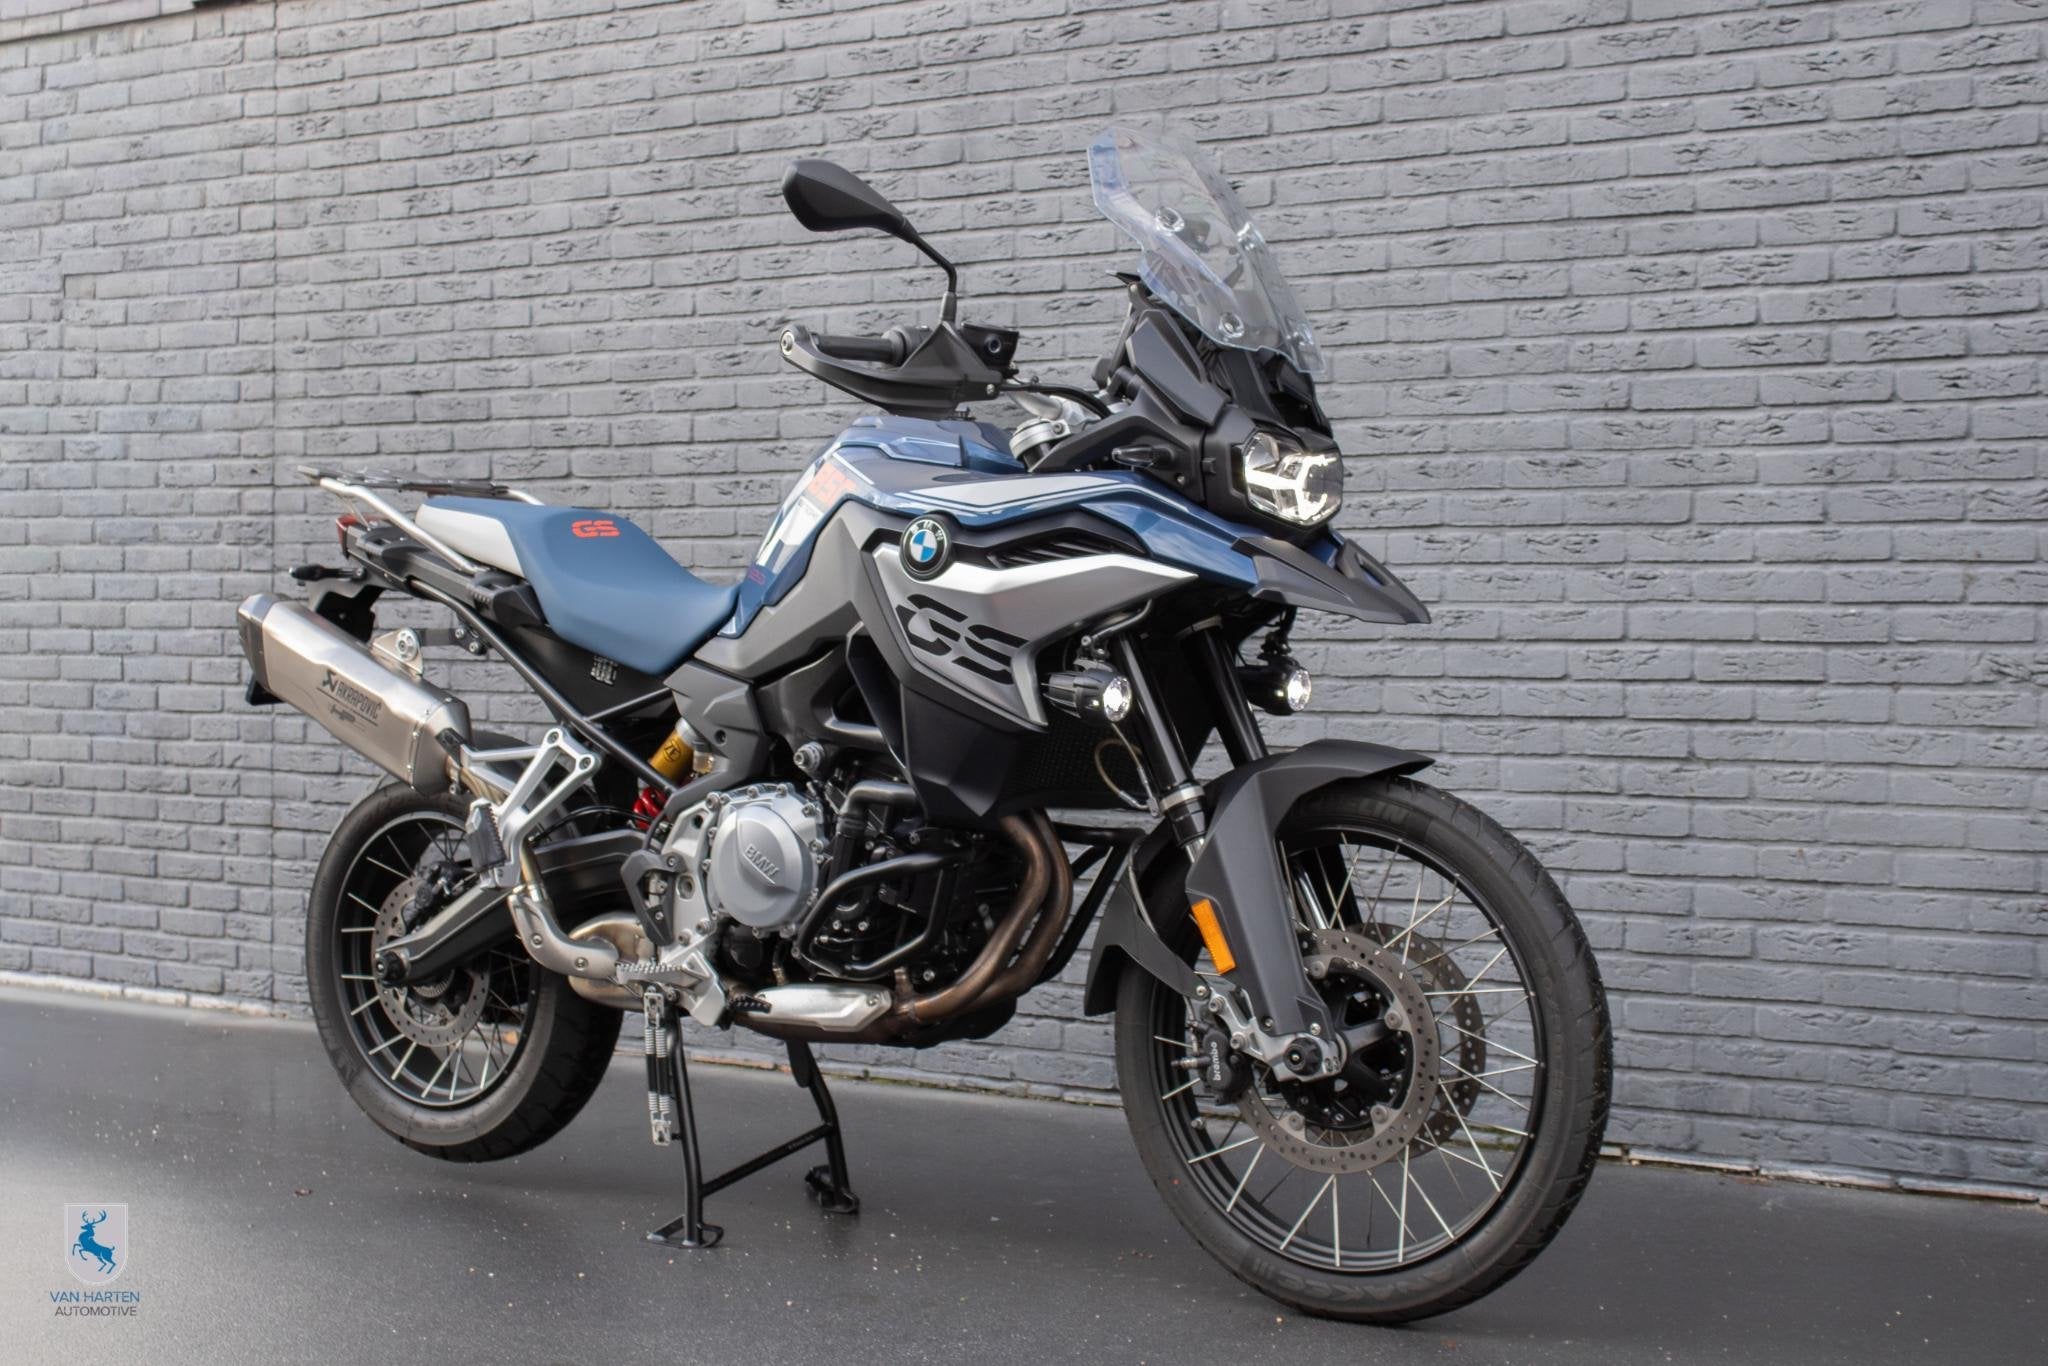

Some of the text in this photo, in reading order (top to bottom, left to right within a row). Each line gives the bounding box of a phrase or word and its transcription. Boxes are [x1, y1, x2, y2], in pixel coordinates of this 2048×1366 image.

[571, 520, 620, 538] GS
[910, 520, 945, 541] BMW
[895, 593, 1030, 686] GS
[744, 843, 780, 877] BMW
[1209, 1041, 1221, 1081] brembo
